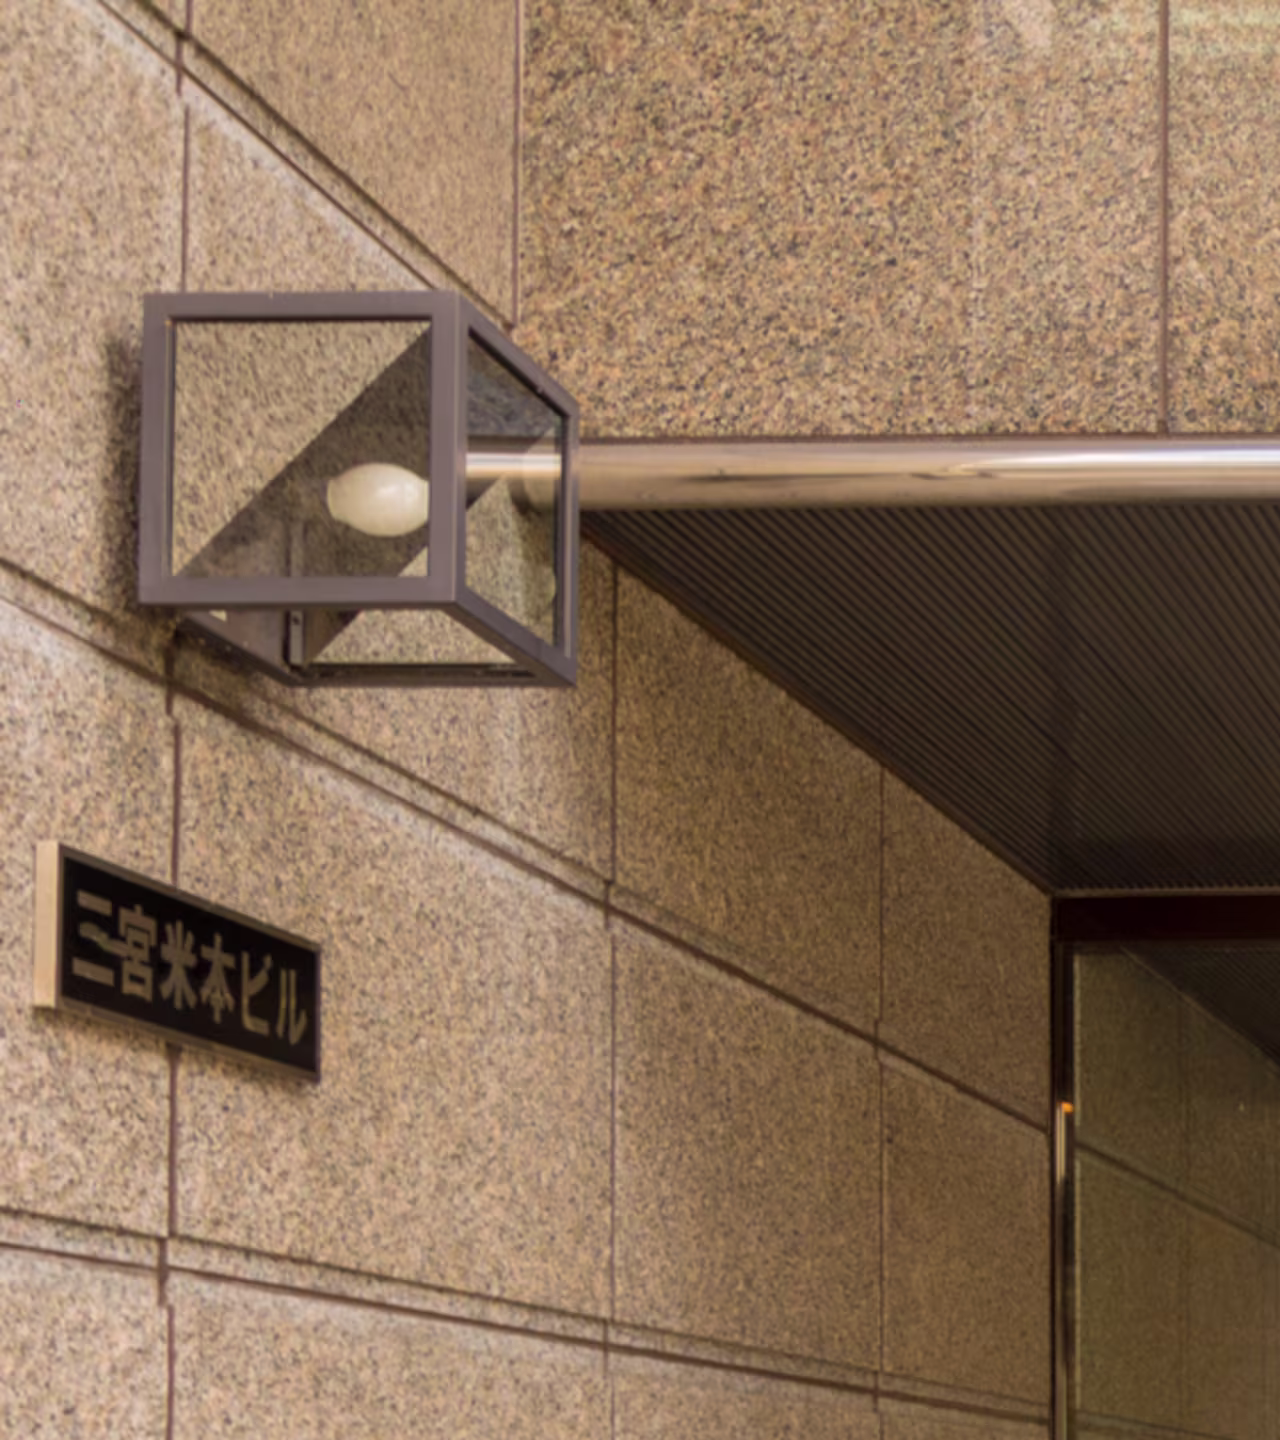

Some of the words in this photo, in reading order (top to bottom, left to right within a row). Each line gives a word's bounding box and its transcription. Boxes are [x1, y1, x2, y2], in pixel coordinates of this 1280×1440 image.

[72, 889, 307, 1046] 三宮米本ビル
